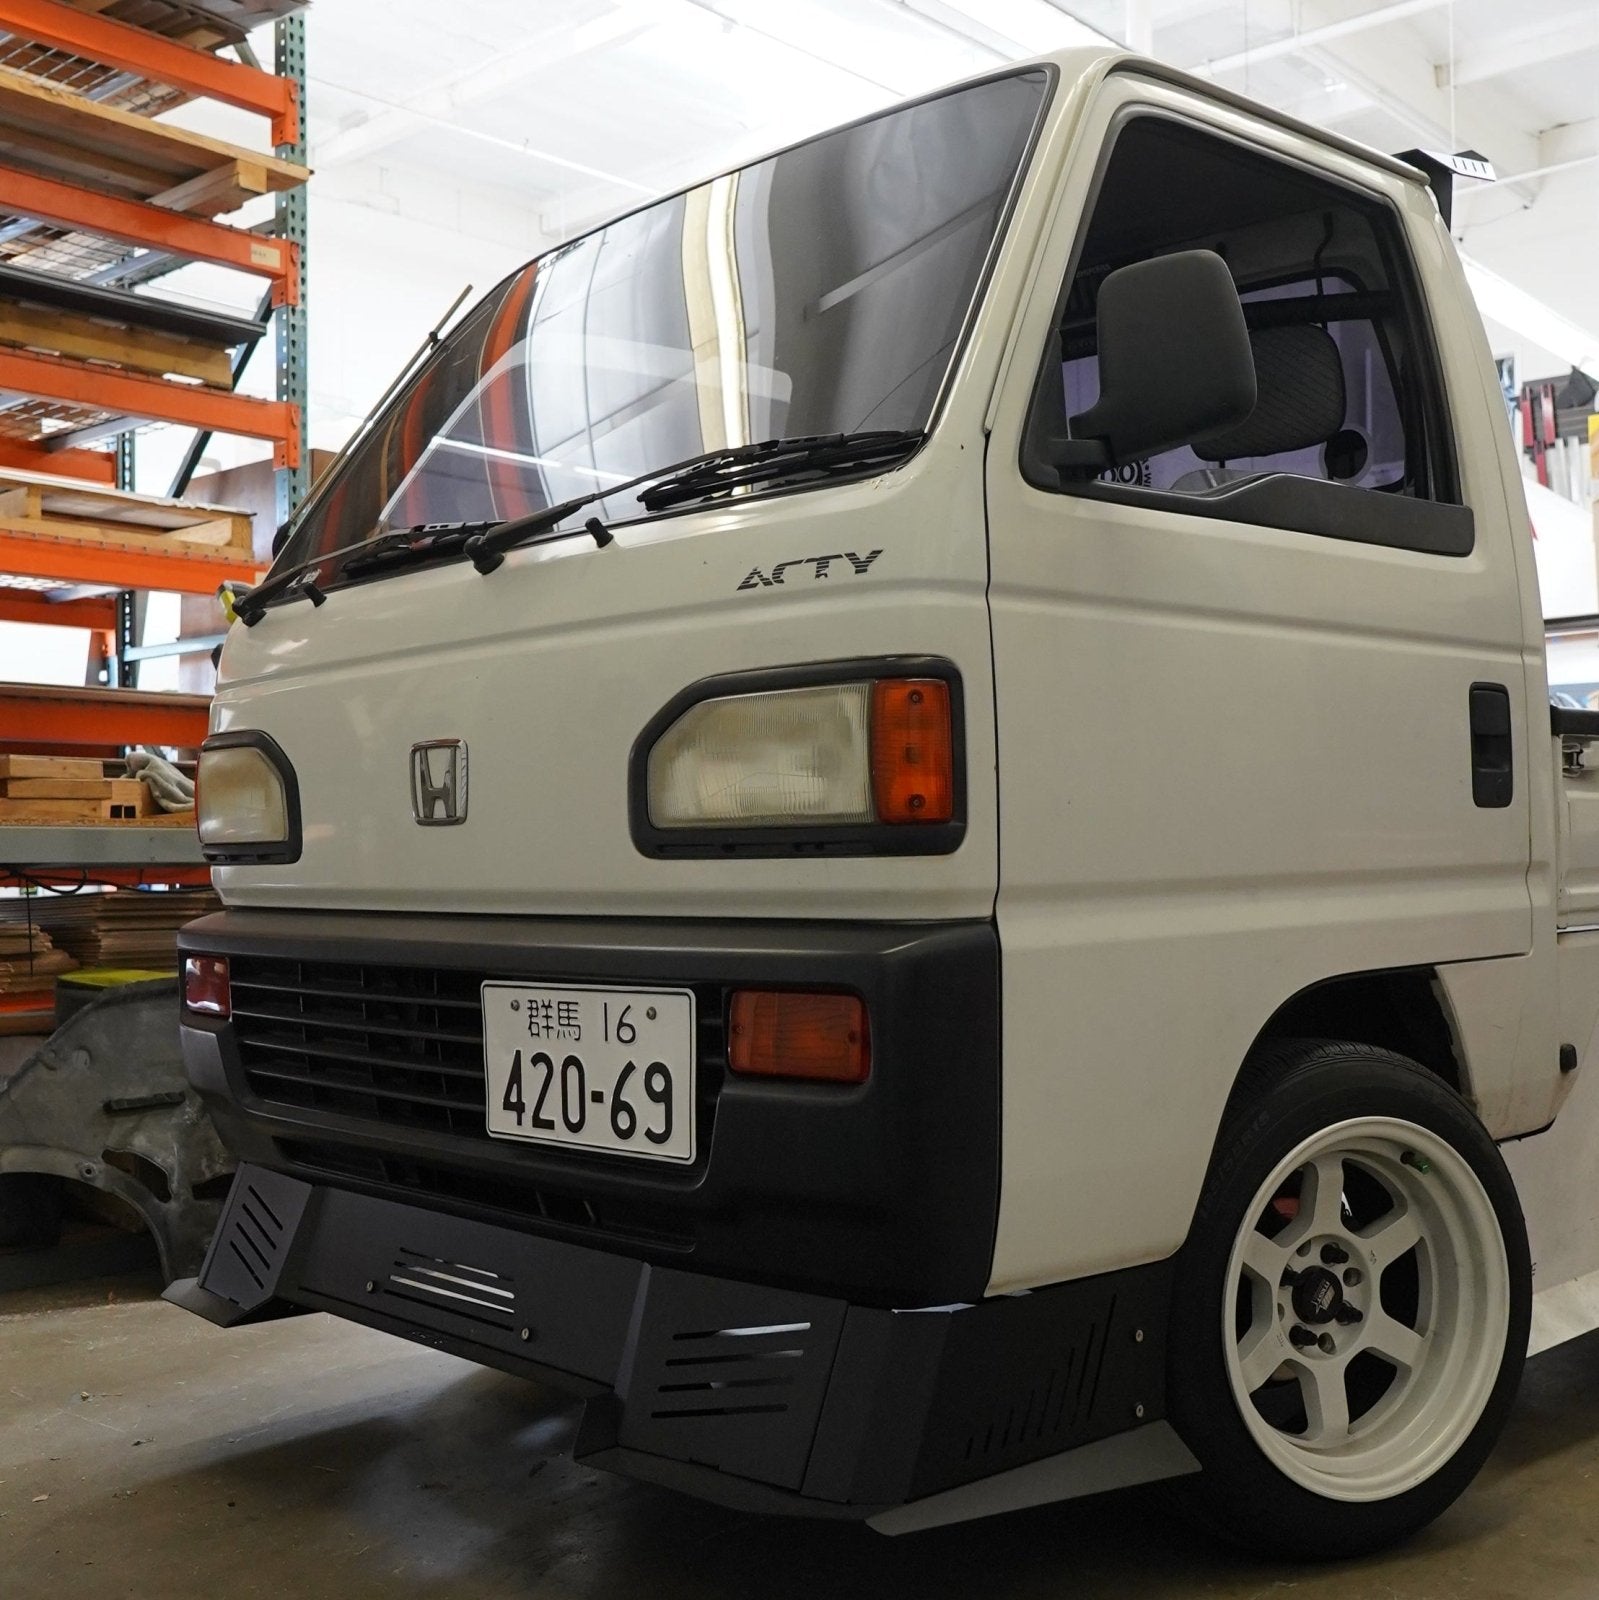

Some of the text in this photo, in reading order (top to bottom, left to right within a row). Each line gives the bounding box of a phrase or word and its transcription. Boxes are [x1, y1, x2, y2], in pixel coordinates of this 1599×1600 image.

[736, 549, 884, 591] ACTY
[526, 998, 638, 1045] 群馬 16
[501, 1049, 673, 1146] 420-69
